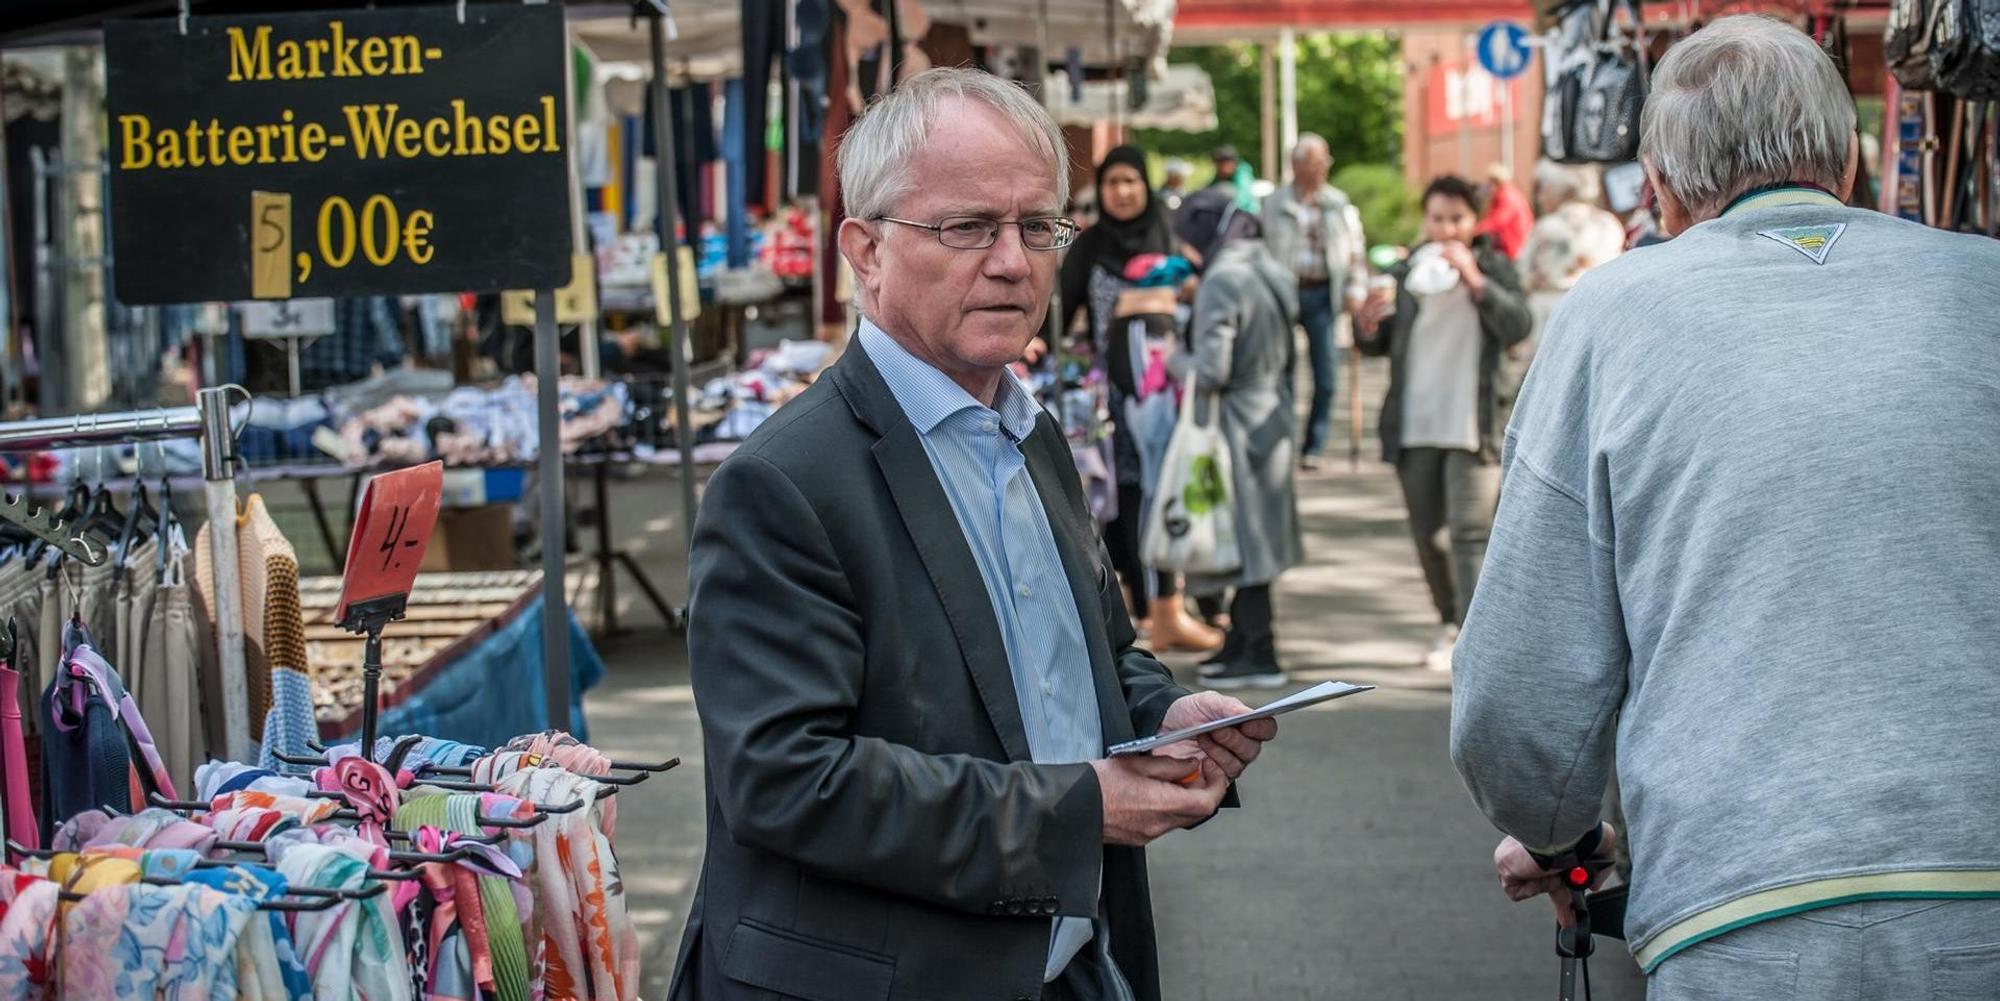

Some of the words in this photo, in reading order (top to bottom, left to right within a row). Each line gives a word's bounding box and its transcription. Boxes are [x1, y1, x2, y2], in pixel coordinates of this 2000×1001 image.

[226, 20, 443, 82] Marken-
[118, 96, 560, 169] Batterie-Wechsel
[260, 194, 435, 284] 5,00€
